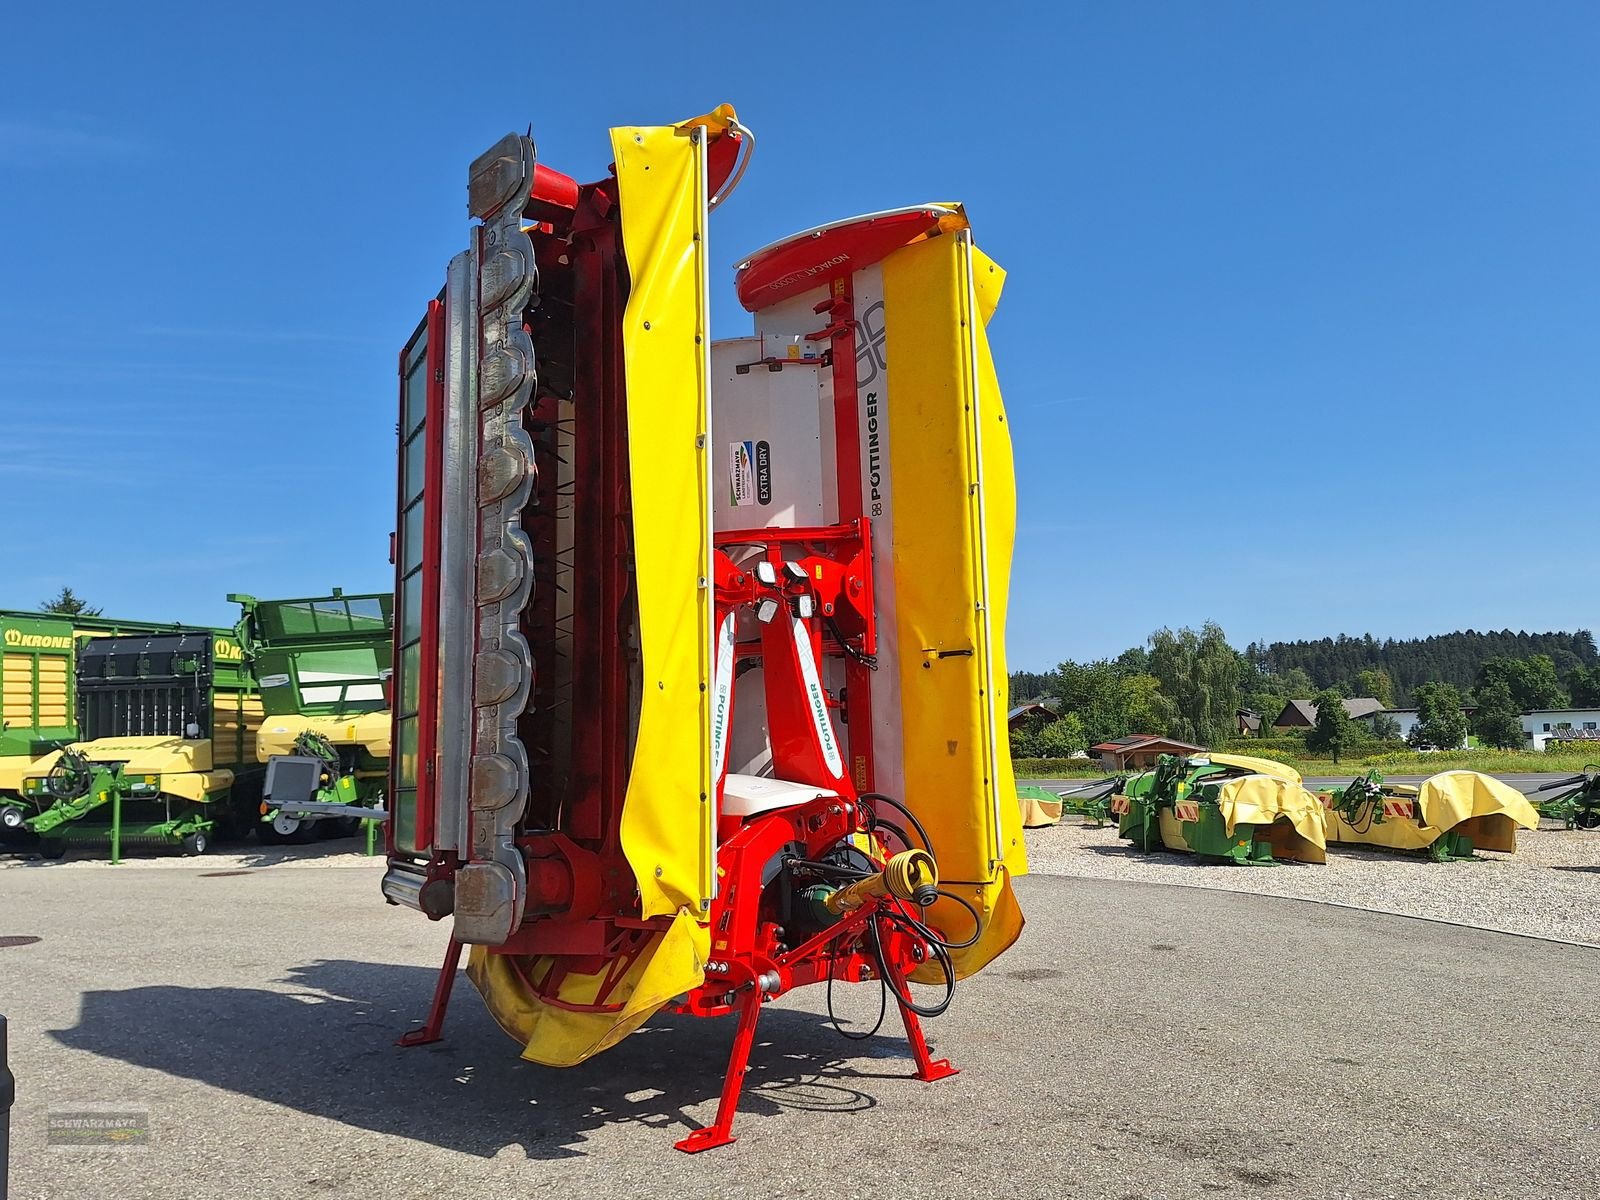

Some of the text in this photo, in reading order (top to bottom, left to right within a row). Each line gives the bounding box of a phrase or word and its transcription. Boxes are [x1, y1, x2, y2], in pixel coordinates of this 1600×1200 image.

[804, 253, 851, 277] NOVACAT
[759, 446, 769, 499] EXTRA DRY
[20, 634, 73, 649] KRONE
